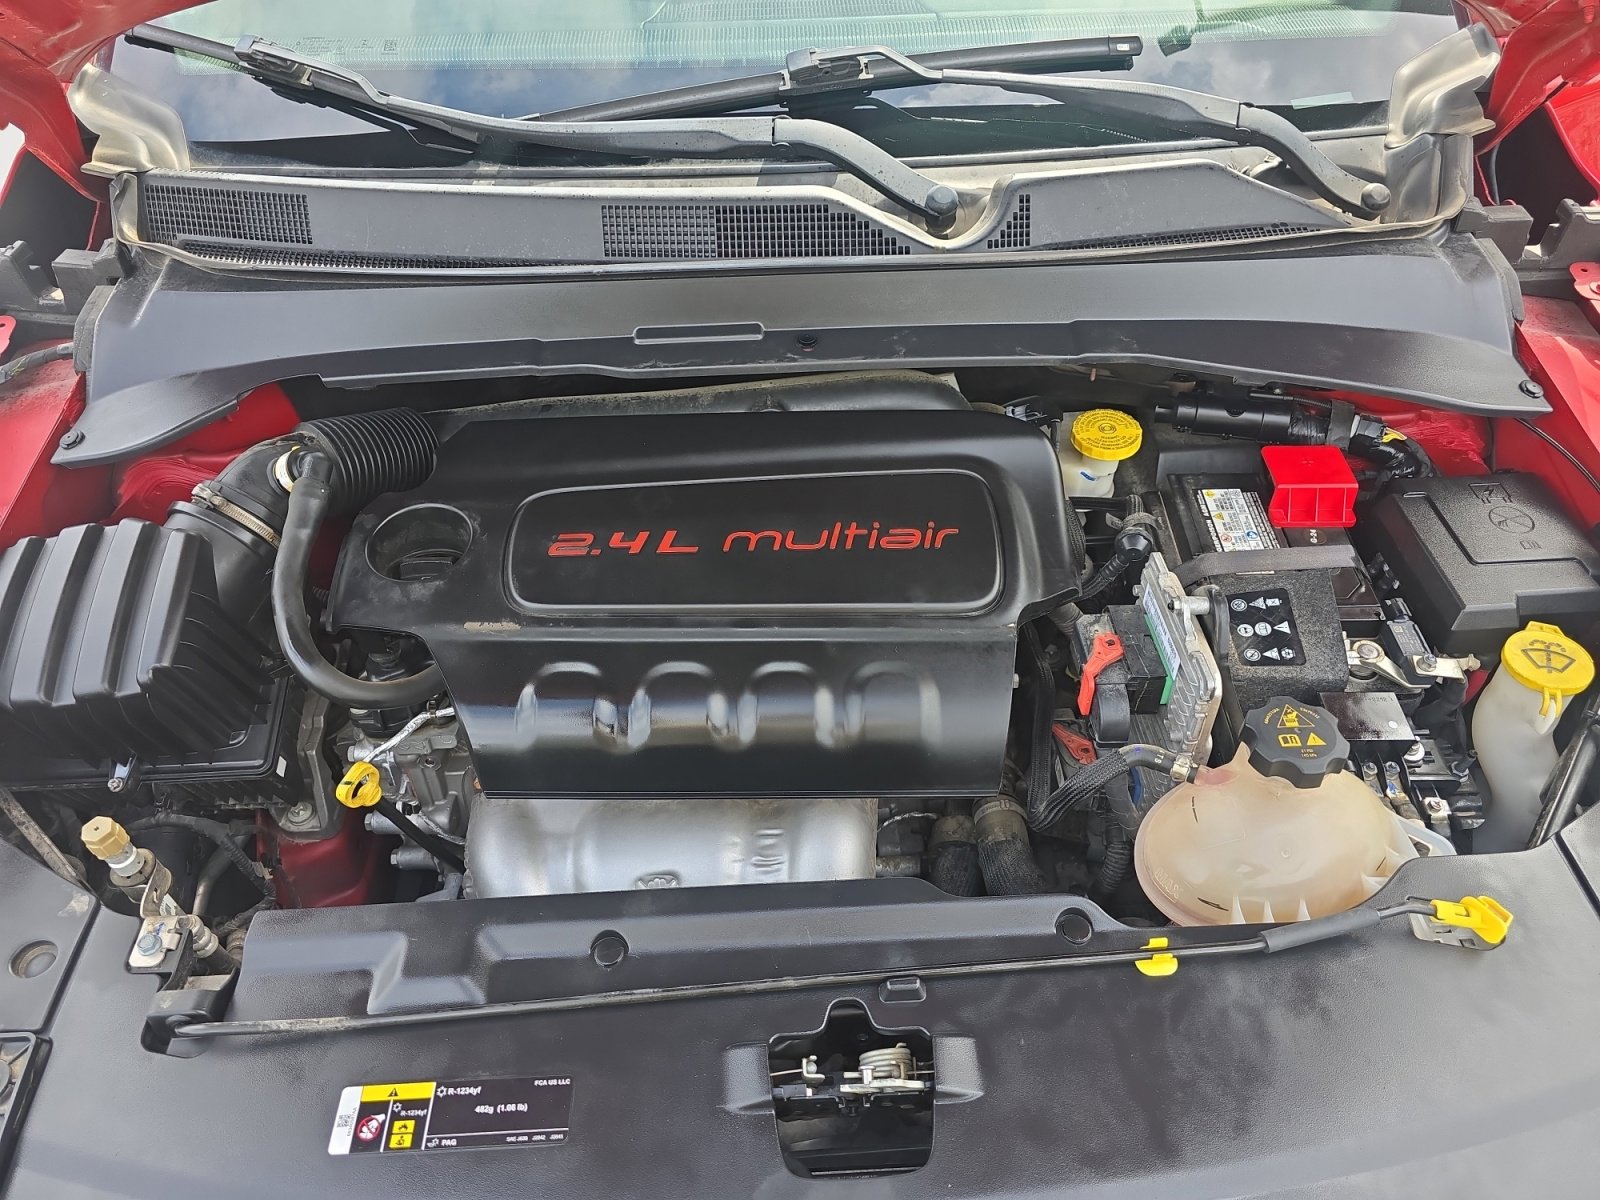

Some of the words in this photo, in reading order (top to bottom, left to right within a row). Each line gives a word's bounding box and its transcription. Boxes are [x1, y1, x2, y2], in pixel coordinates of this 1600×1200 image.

[722, 521, 959, 553] multiair
[447, 1086, 482, 1096] R-1234yf
[474, 1105, 494, 1114] 482g
[441, 1139, 457, 1147] PAG
